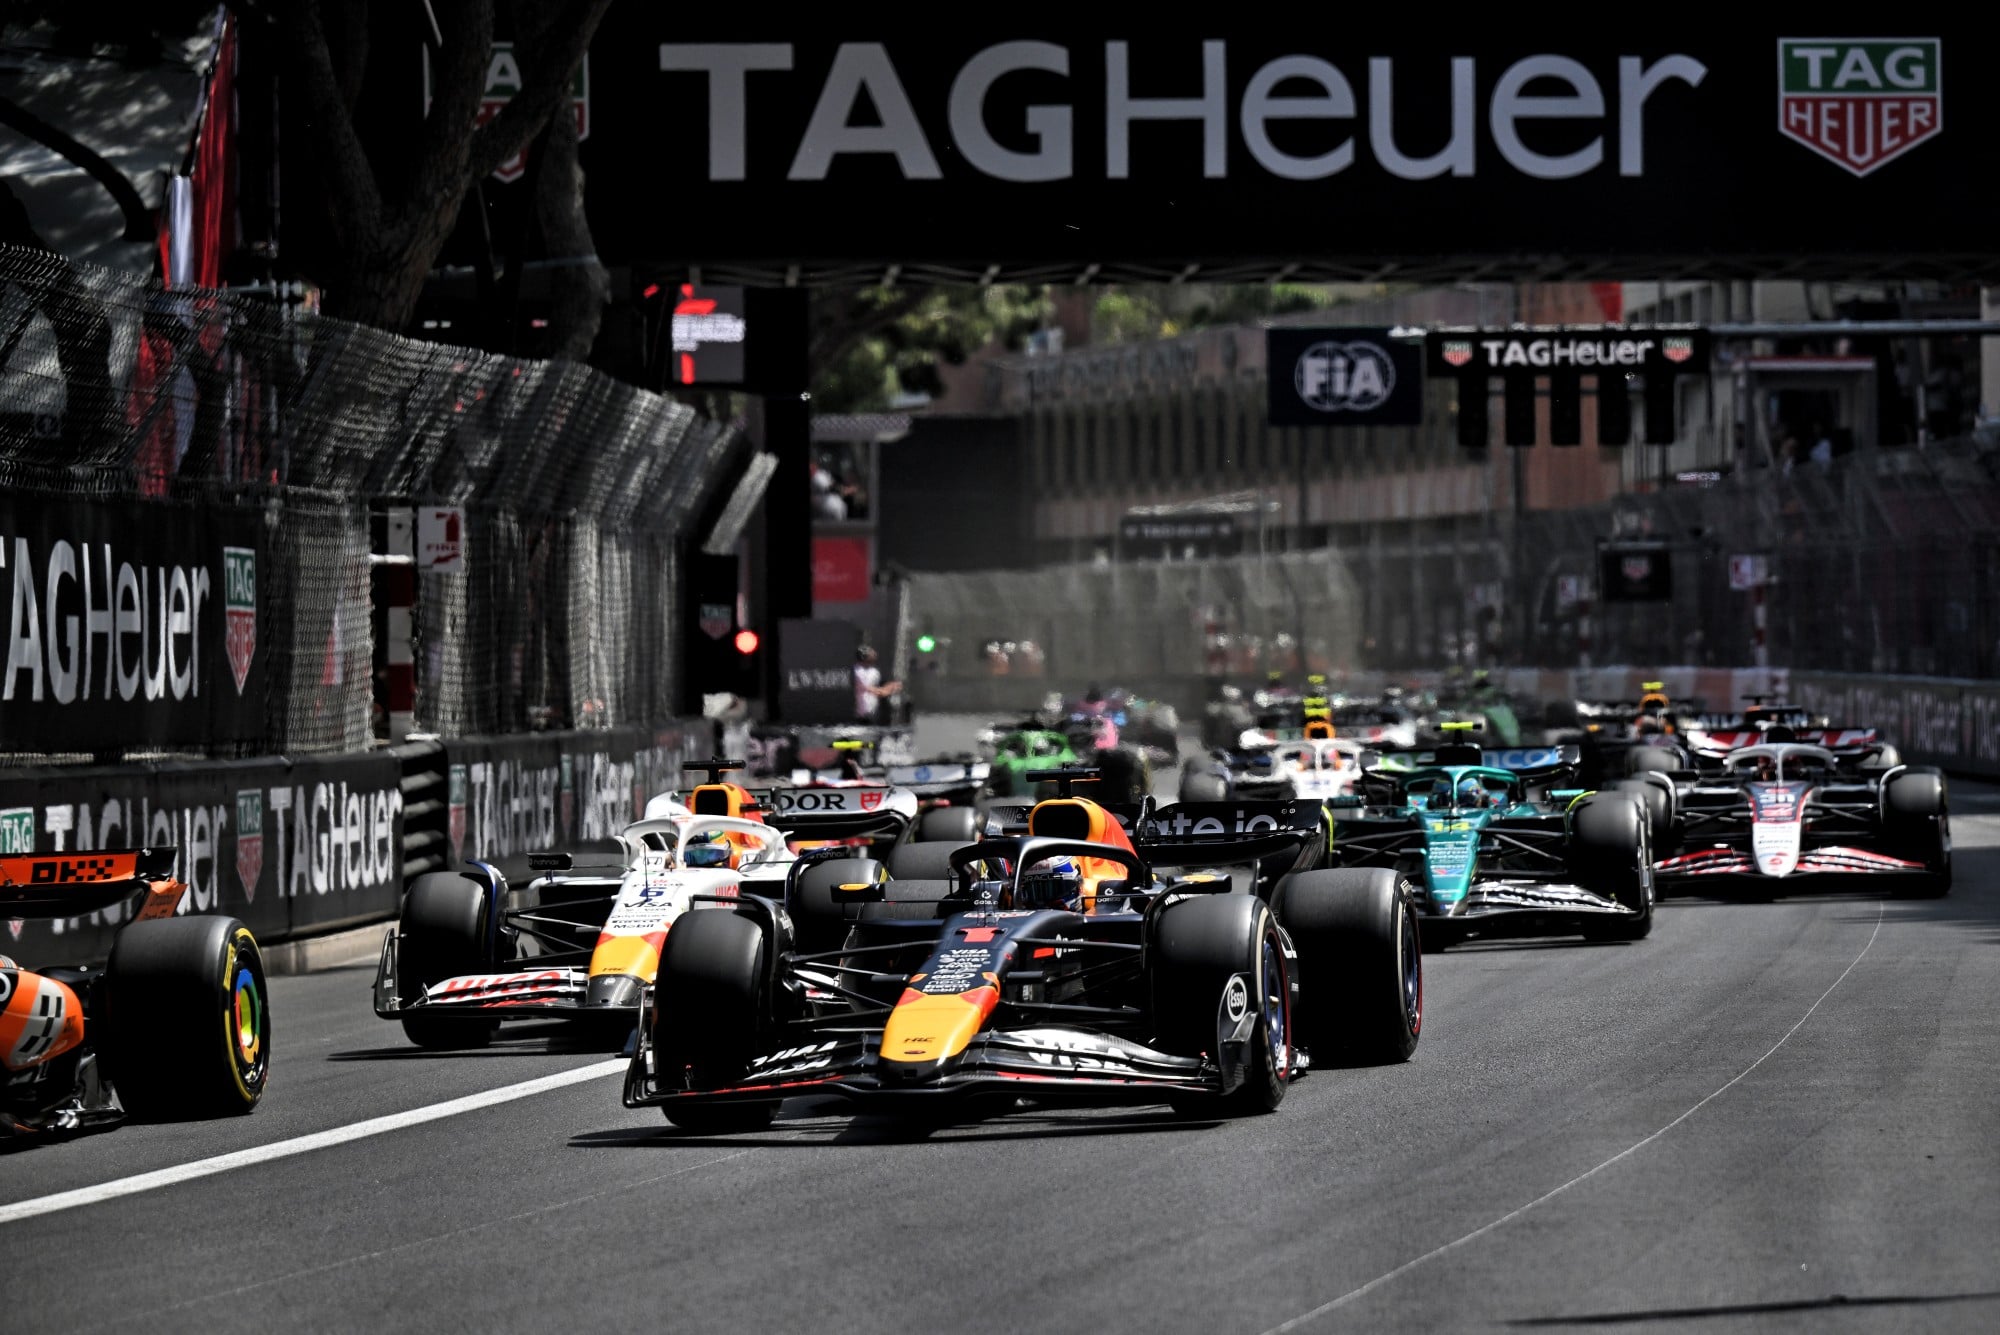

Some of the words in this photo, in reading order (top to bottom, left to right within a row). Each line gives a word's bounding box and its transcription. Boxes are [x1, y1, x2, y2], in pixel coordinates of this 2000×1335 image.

[1792, 47, 1926, 88] TAG
[1788, 101, 1932, 166] HEUER
[226, 556, 254, 604] TAG
[0, 535, 210, 705] AGHeuer
[270, 780, 403, 898] TAGHeuer
[1116, 809, 1278, 838] ateio
[440, 970, 561, 1002] HUGO
[1230, 988, 1244, 1008] Esso
